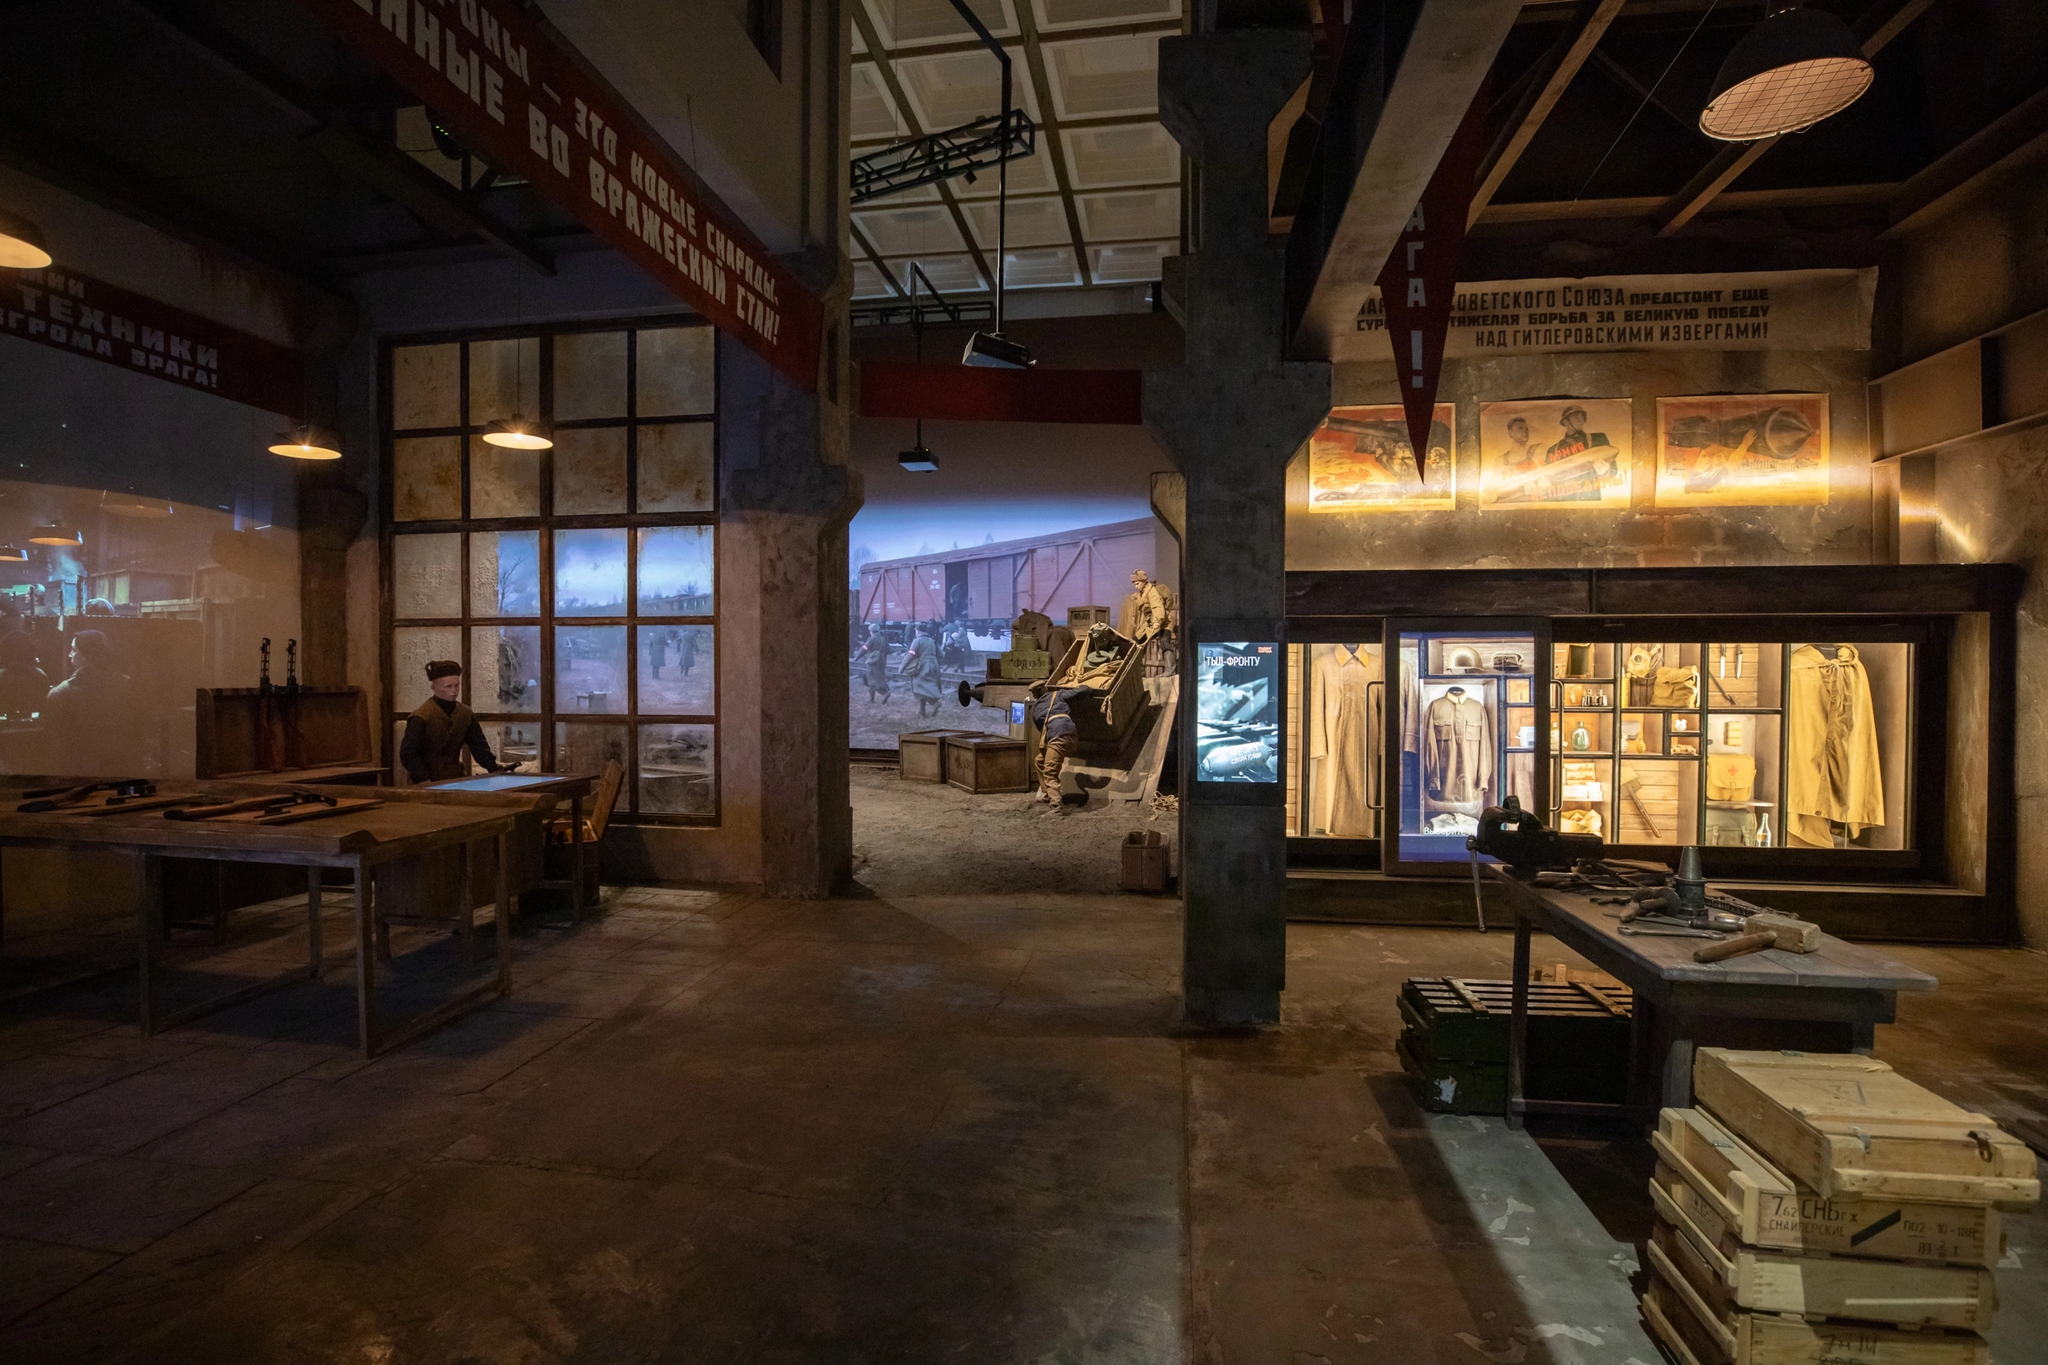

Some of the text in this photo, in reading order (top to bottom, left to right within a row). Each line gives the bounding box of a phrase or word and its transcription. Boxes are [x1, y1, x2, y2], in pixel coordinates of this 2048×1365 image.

[528, 102, 571, 179] ВО
[588, 156, 728, 305] ВРАЖЕСКИЙ
[736, 283, 781, 346] СТАН!
[574, 97, 618, 167] ЭТО
[630, 150, 698, 238] НОВЫЕ
[705, 220, 781, 308] СНАРЯДЫ,
[16, 283, 218, 370] ТЕХНИКИ
[1449, 290, 1556, 312] ОВЕТСКОГО
[1630, 290, 1723, 305] ПРЕДСТОИТ
[1449, 314, 1520, 327] ТЯЖЕЛАЯ
[1528, 311, 1588, 325] БОРЬБА
[1596, 311, 1616, 323] ЗА
[1623, 308, 1699, 322] ВЕЛИКУЮ
[1707, 305, 1770, 319] ПОБЕДУ
[0, 307, 219, 389] ГРОМА ВРАГА!
[1475, 322, 1769, 348] НАД ГИТЛЕРОВСКИМИ ИЗВЕРГАМИ!
[1206, 656, 1261, 667] ТЫЛ-ФРОНТУ
